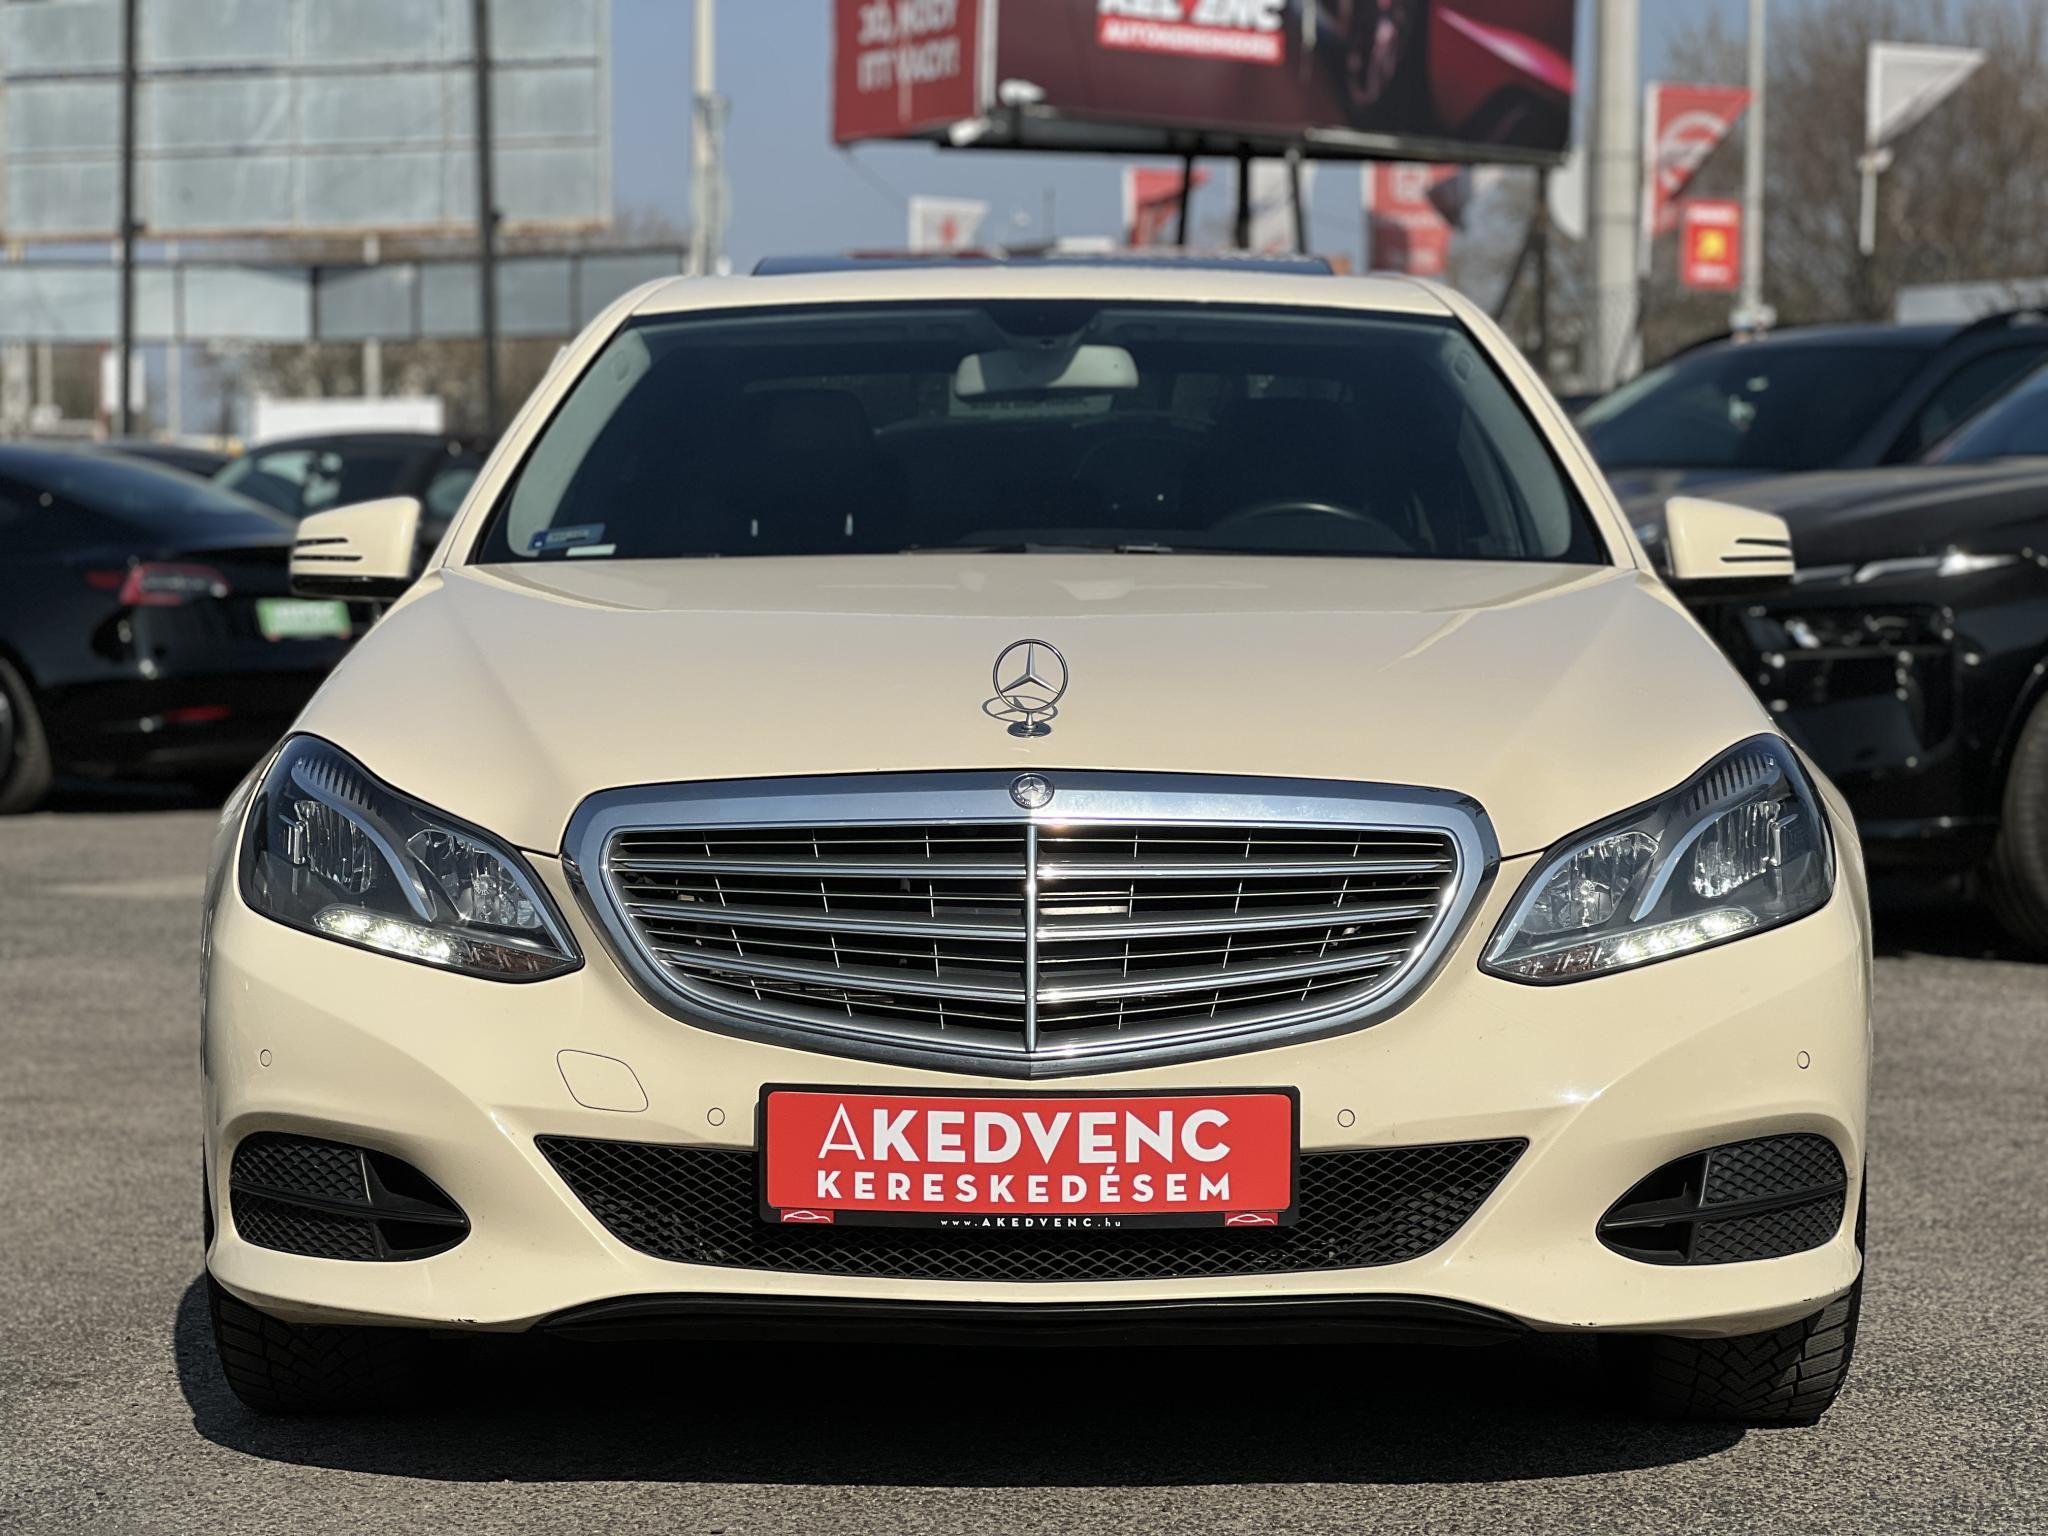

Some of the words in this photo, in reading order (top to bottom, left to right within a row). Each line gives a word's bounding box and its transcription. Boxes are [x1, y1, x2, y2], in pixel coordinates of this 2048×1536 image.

[818, 1103, 1231, 1165] AKEDVENC
[817, 1166, 1230, 1203] KERESKEDÉSEM
[940, 1216, 1122, 1228] www.AKEDVENC.hu
